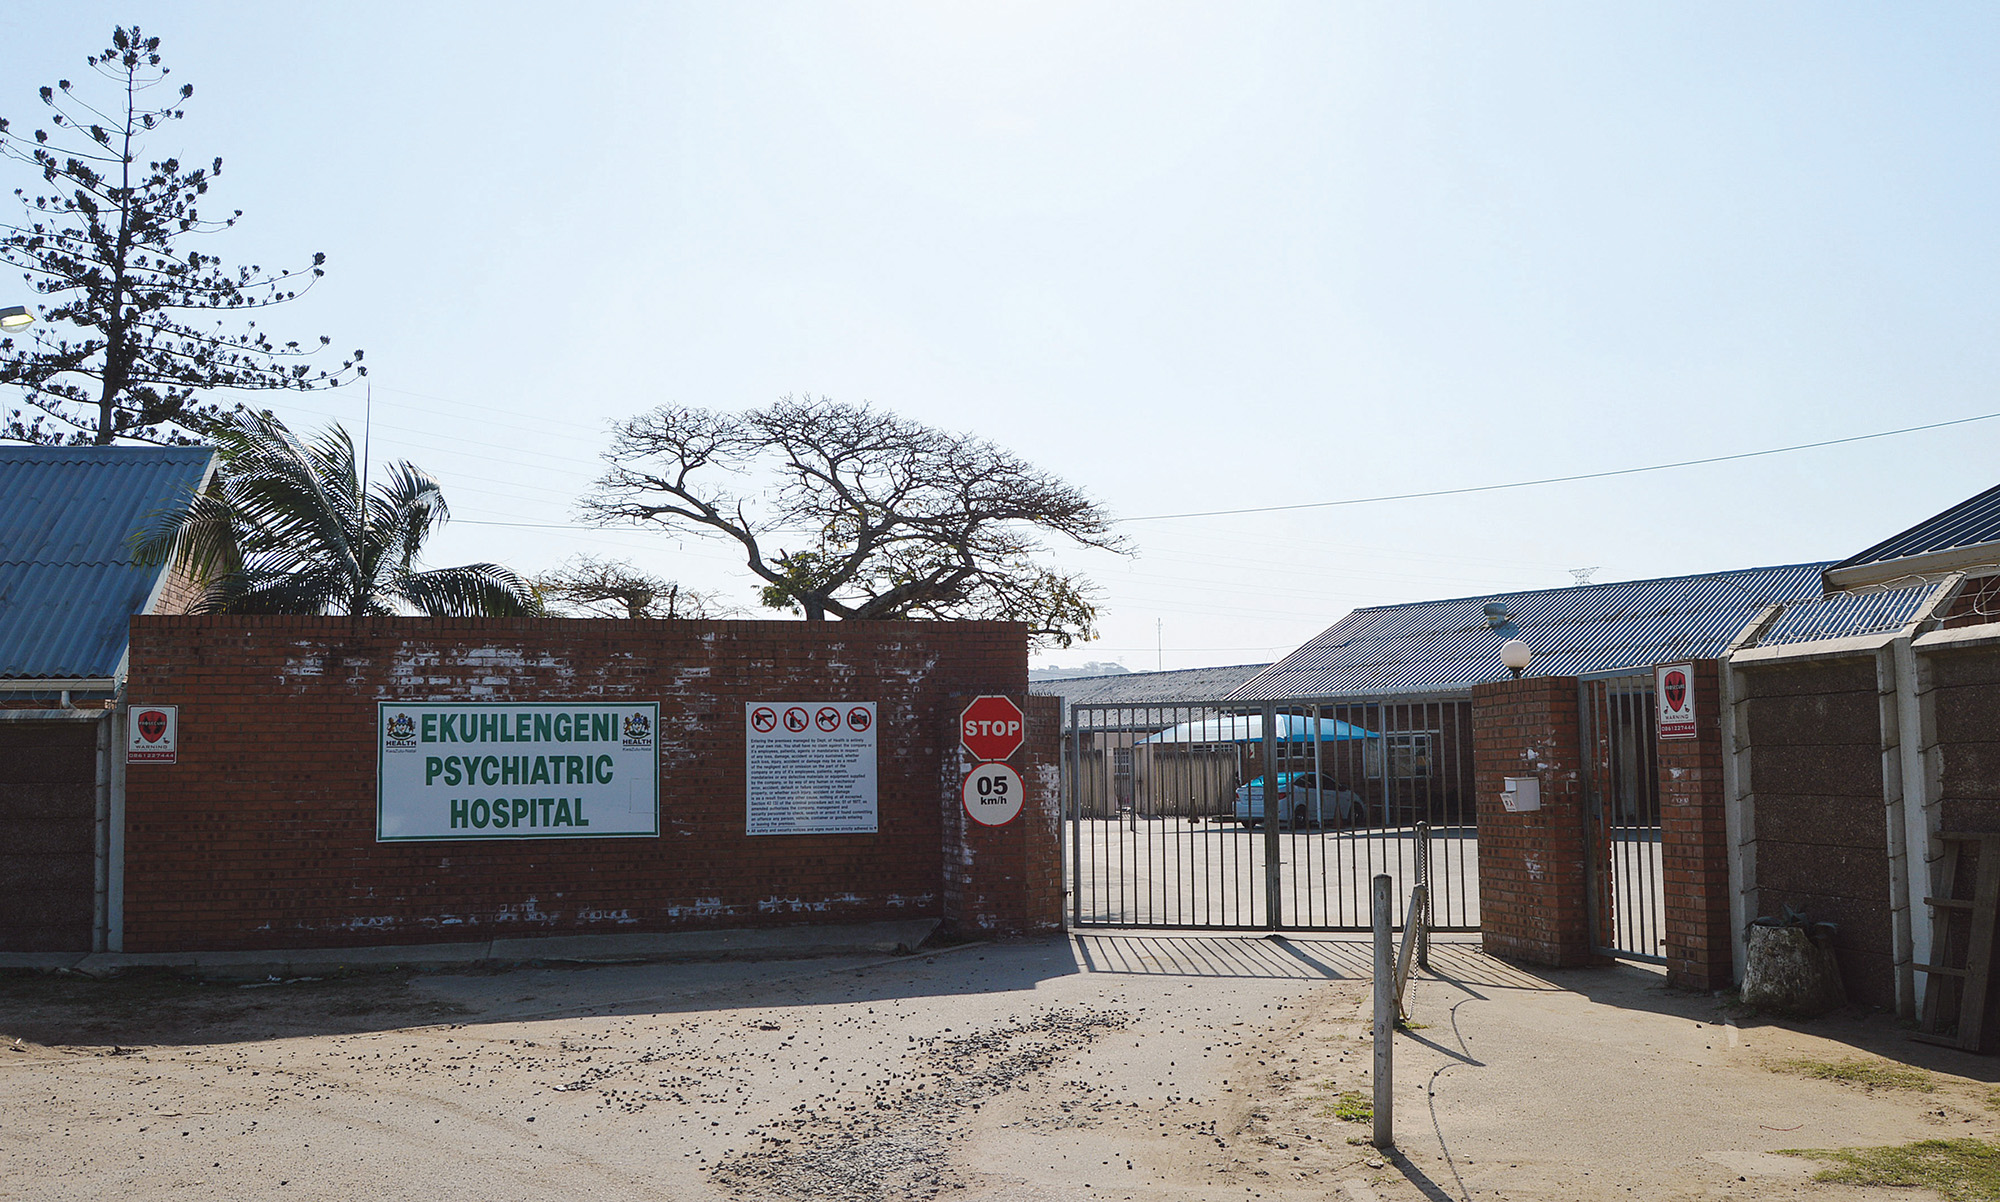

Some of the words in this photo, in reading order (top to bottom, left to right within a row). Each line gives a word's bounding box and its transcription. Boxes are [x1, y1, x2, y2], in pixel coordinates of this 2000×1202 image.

[421, 713, 619, 742] EKUHLENGENI
[965, 720, 1020, 736] STOP
[425, 754, 614, 786] PSYCHIATRIC
[977, 776, 1008, 796] 05
[980, 796, 1007, 805] km/h
[450, 798, 589, 828] HOSPITAL
